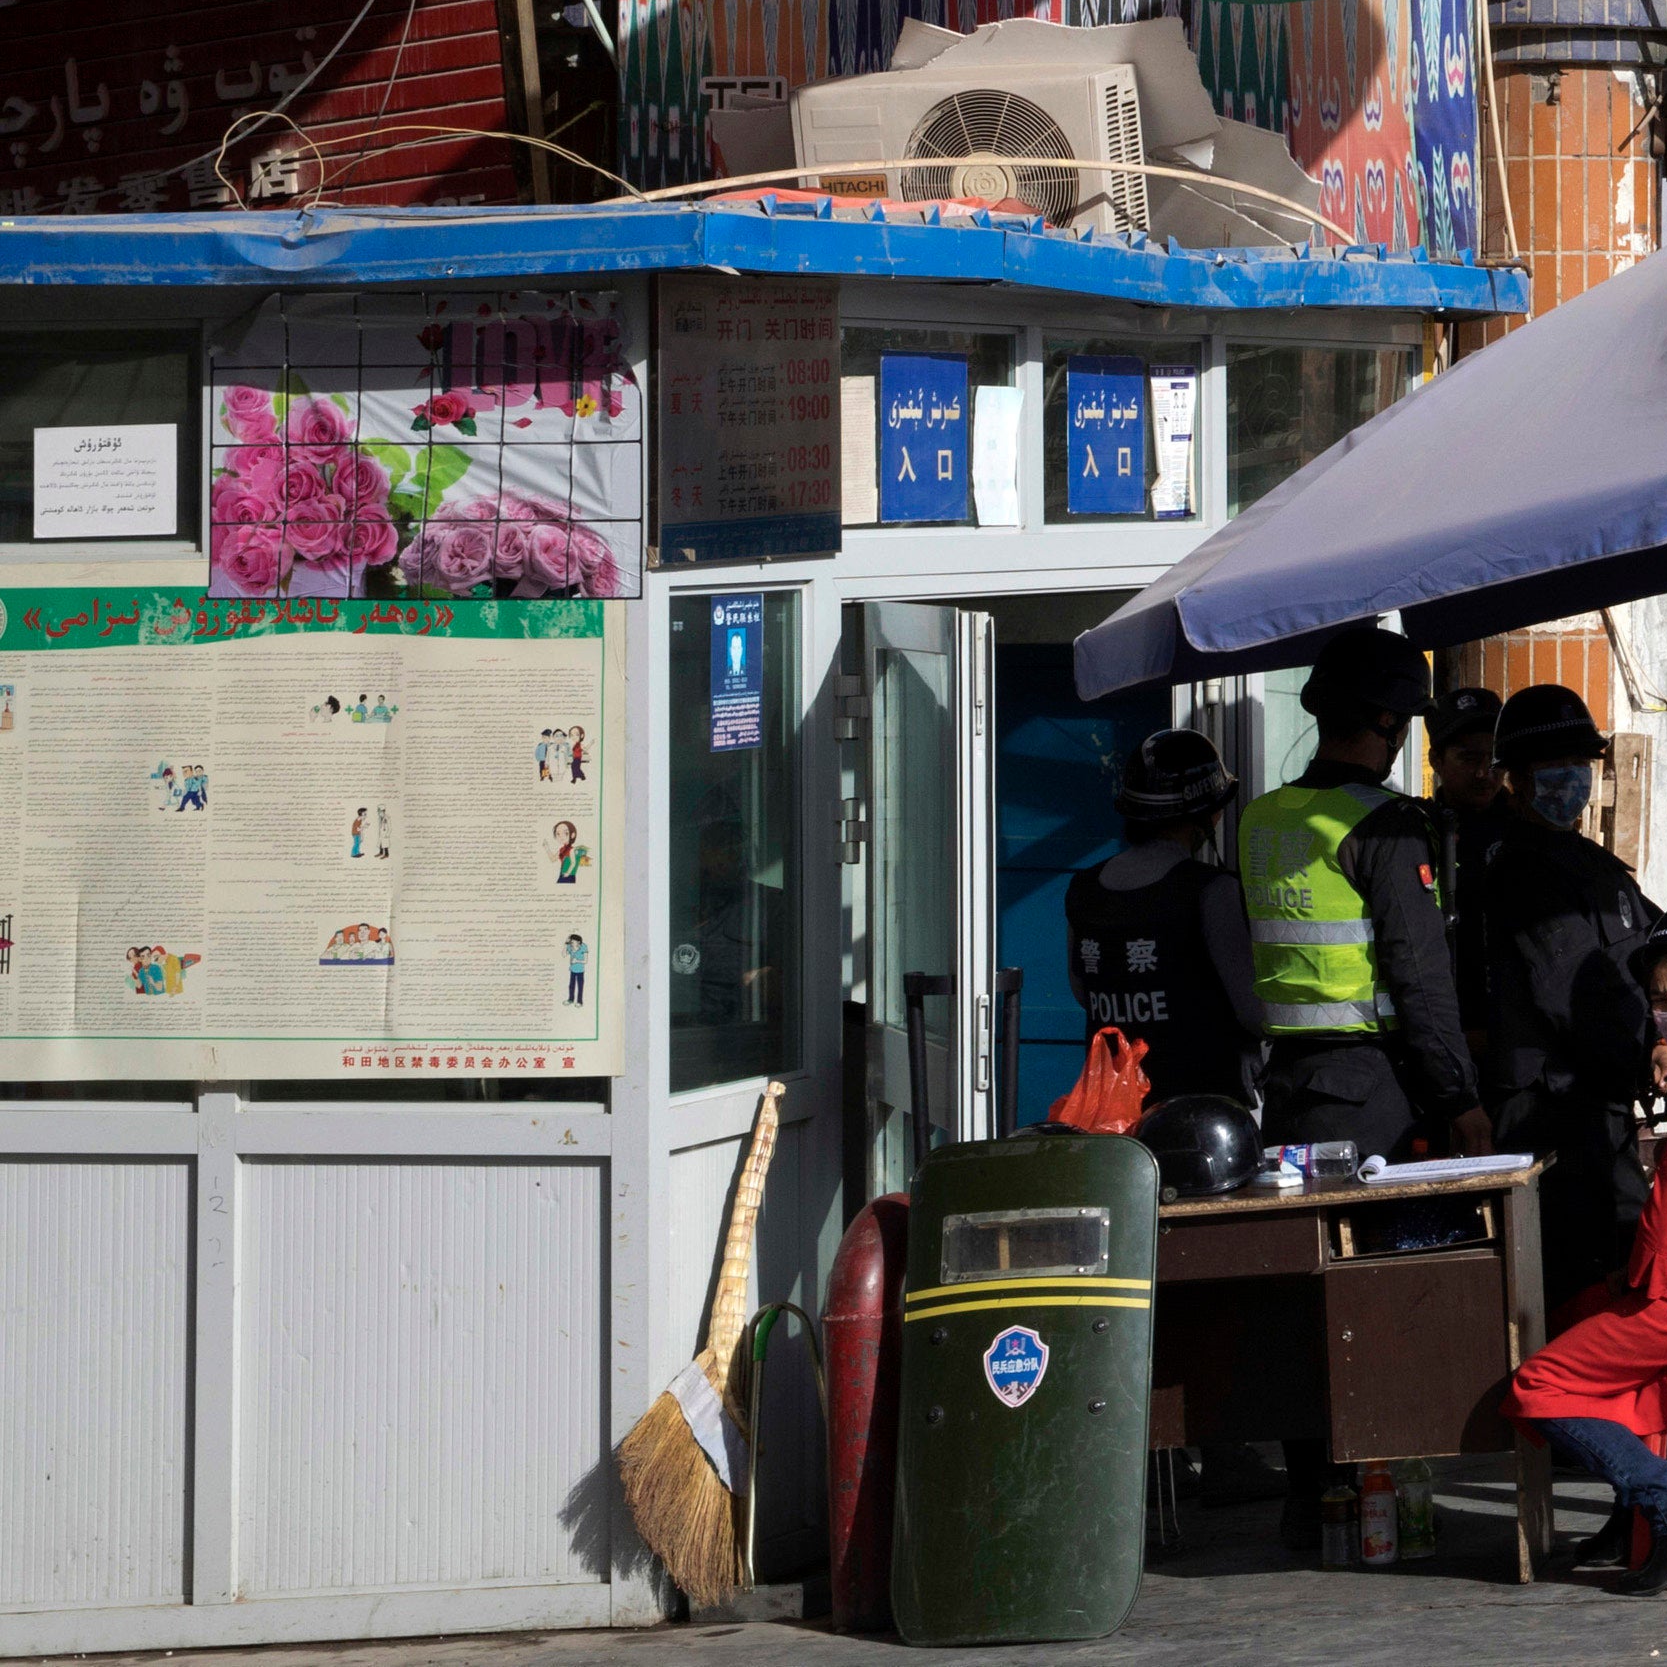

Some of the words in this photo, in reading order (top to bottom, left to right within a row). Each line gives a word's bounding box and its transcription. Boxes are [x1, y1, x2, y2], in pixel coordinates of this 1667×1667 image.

[820, 179, 886, 194] HITACHI
[765, 317, 834, 341] 关门时间
[1247, 885, 1314, 910] POLICE
[1079, 937, 1160, 975] 警察
[1090, 989, 1171, 1025] POLICE
[342, 1055, 546, 1069] 和田地区禁毒委员会办公室
[991, 1357, 1040, 1375] 民兵应急分队
